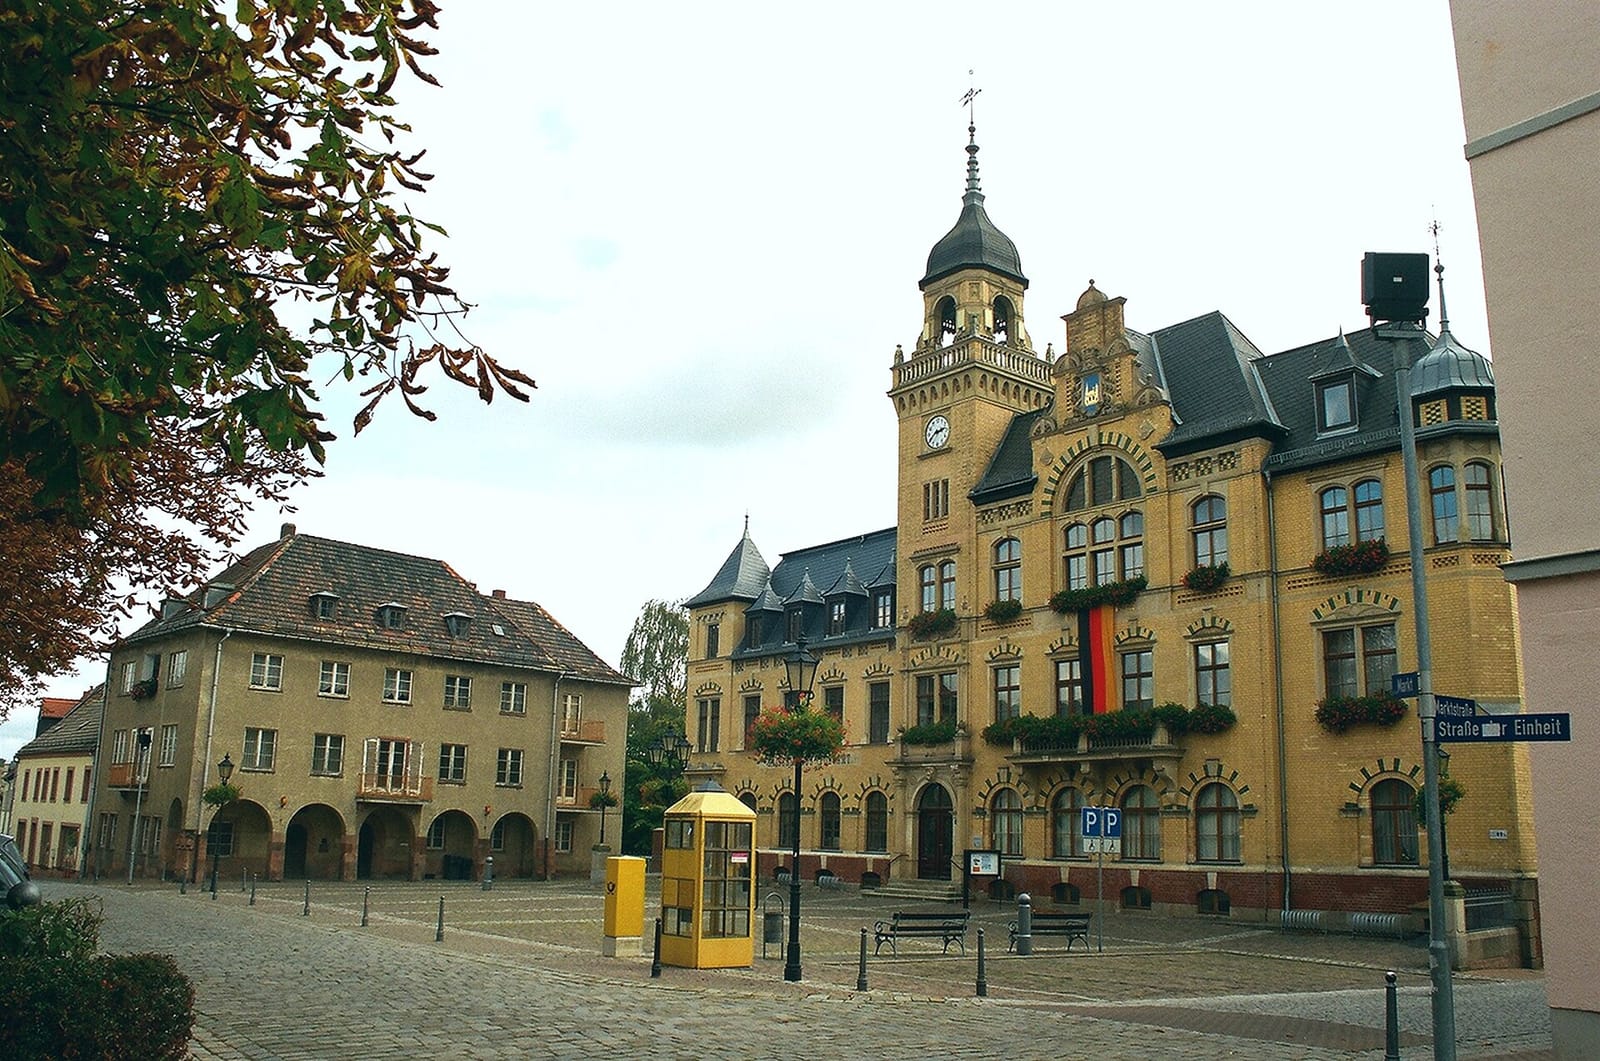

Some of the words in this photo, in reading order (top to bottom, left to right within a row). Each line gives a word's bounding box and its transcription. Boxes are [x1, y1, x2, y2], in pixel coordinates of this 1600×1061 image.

[1439, 720, 1480, 737] Straße
[1514, 719, 1562, 735] Einheit
[1086, 811, 1097, 833] P
[1107, 812, 1118, 834] P
